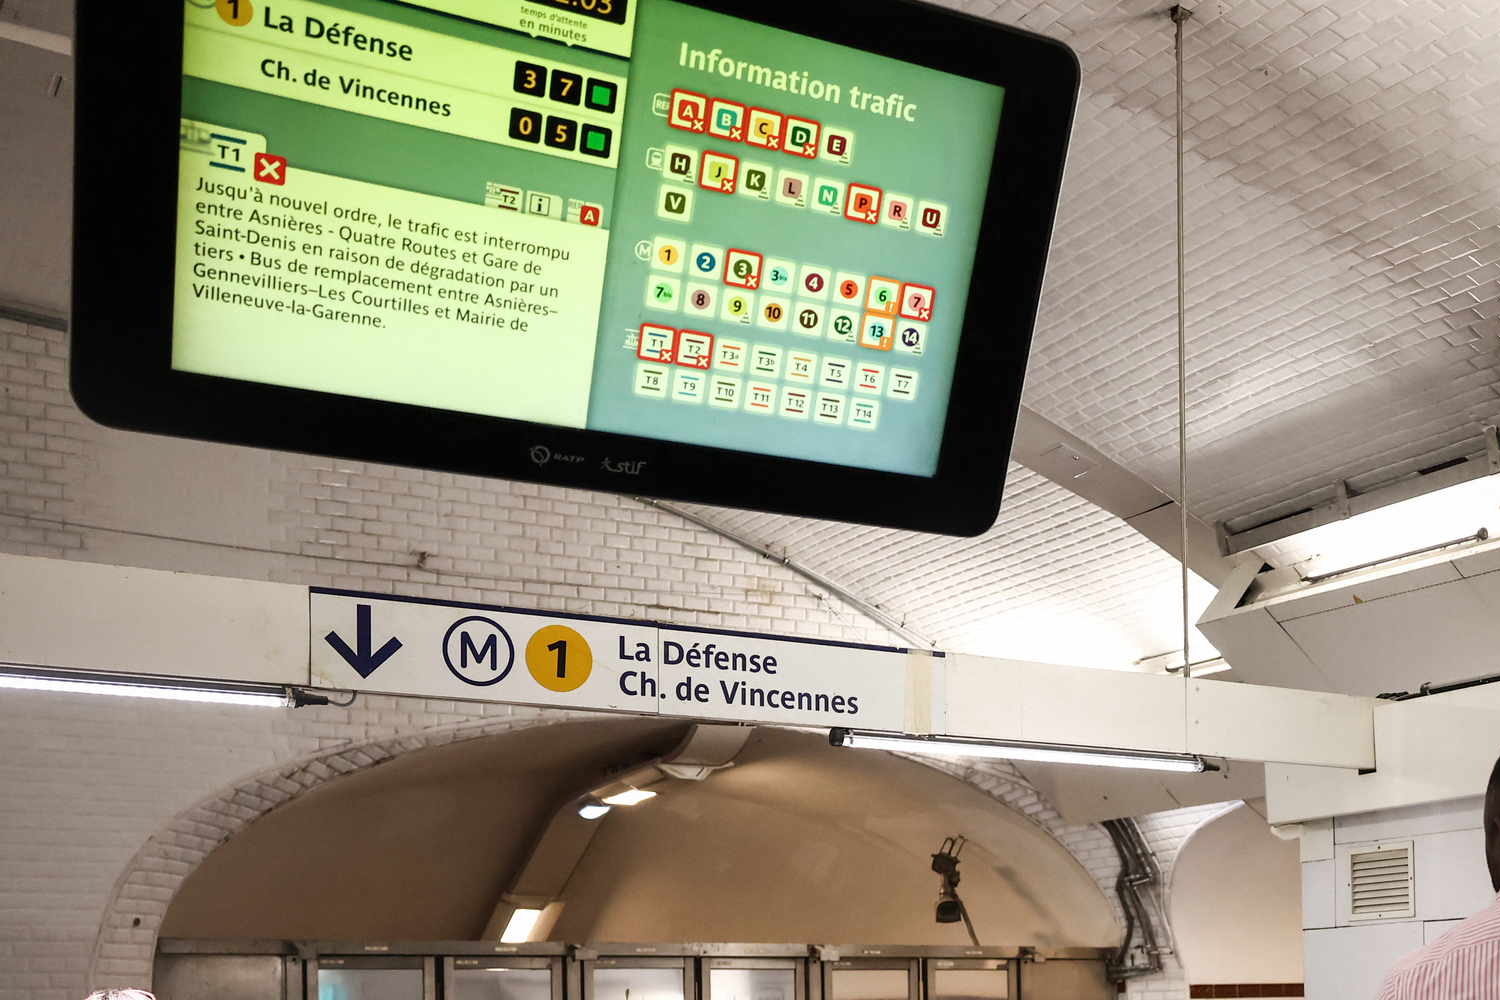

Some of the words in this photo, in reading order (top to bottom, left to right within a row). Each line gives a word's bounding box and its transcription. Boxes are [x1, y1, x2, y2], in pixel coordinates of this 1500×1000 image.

[227, 0, 239, 20] 1
[264, 6, 294, 34] La
[305, 16, 413, 61] Défense
[519, 18, 535, 30] en
[538, 22, 587, 43] minutes
[520, 6, 547, 22] temps
[550, 13, 588, 30] d'attente
[261, 58, 298, 83] Ch.
[304, 69, 331, 91] de
[339, 76, 452, 117] Vincennes
[523, 69, 537, 89] 3
[559, 78, 574, 97] 7
[679, 41, 842, 104] Information
[849, 85, 918, 123] trafic
[519, 116, 533, 136] 0
[554, 125, 568, 143] 5
[682, 103, 695, 118] A
[721, 113, 733, 127] B
[758, 121, 768, 136] C
[796, 130, 808, 144] D
[832, 139, 842, 152] E
[217, 144, 241, 162] T1
[669, 196, 682, 211] V
[674, 157, 687, 171] H
[749, 174, 761, 188] K
[787, 181, 796, 195] L
[822, 189, 834, 203] N
[858, 197, 868, 210] P
[892, 205, 903, 218] R
[926, 212, 937, 225] U
[196, 177, 263, 204] Jusqu'à
[270, 193, 328, 216] nouvel
[333, 207, 382, 229] ordre,
[388, 213, 402, 230] le
[407, 218, 450, 239] trafic
[454, 229, 478, 244] est
[483, 231, 570, 262] interrompu
[196, 201, 244, 220] entre
[248, 209, 323, 236] Asnières
[339, 225, 396, 249] Quatre
[402, 238, 457, 260] Routes
[462, 250, 479, 265] et
[483, 252, 519, 272] Gare
[523, 260, 542, 276] de
[194, 241, 234, 262] tiers
[250, 251, 282, 270] Bus
[287, 258, 308, 275] de
[314, 265, 434, 298] remplacement
[438, 286, 480, 305] entre
[195, 219, 297, 252] Saint-Denis
[302, 242, 323, 257] en
[329, 247, 380, 267] raison
[385, 256, 405, 272] de
[410, 259, 505, 289] dégradation
[510, 279, 536, 294] par
[539, 285, 559, 298] un
[701, 255, 711, 269] 2
[738, 262, 747, 276] 3
[808, 276, 819, 289] 4
[845, 283, 854, 296] 5
[878, 289, 887, 302] 6
[913, 296, 922, 308] 7
[192, 282, 387, 329] Villeneuve-la-Garenne.
[351, 289, 430, 316] Courtilles
[434, 305, 451, 320] et
[456, 307, 505, 329] Mairie
[510, 317, 529, 333] de
[696, 293, 706, 307] 8
[733, 299, 742, 313] 9
[766, 305, 781, 320] 10
[801, 311, 817, 326] 11
[834, 317, 851, 332] 12
[870, 324, 884, 338] 13
[903, 330, 918, 345] 14
[651, 337, 664, 348] T1
[687, 343, 700, 355] T2
[794, 361, 808, 373] T4
[829, 367, 842, 379] T5
[863, 372, 876, 384] T6
[897, 378, 909, 390] T7
[646, 375, 659, 387] T8
[683, 380, 696, 392] T9
[716, 385, 735, 398] T10
[752, 391, 770, 403] T11
[787, 396, 805, 409] T12
[821, 401, 839, 414] T13
[855, 407, 872, 419] T14
[553, 453, 585, 463] RATP
[547, 640, 568, 679] 1
[618, 635, 652, 664] La
[664, 641, 778, 676] Défense
[618, 670, 666, 700] Ch.
[675, 673, 708, 703] de
[720, 680, 860, 715] Vincennes
